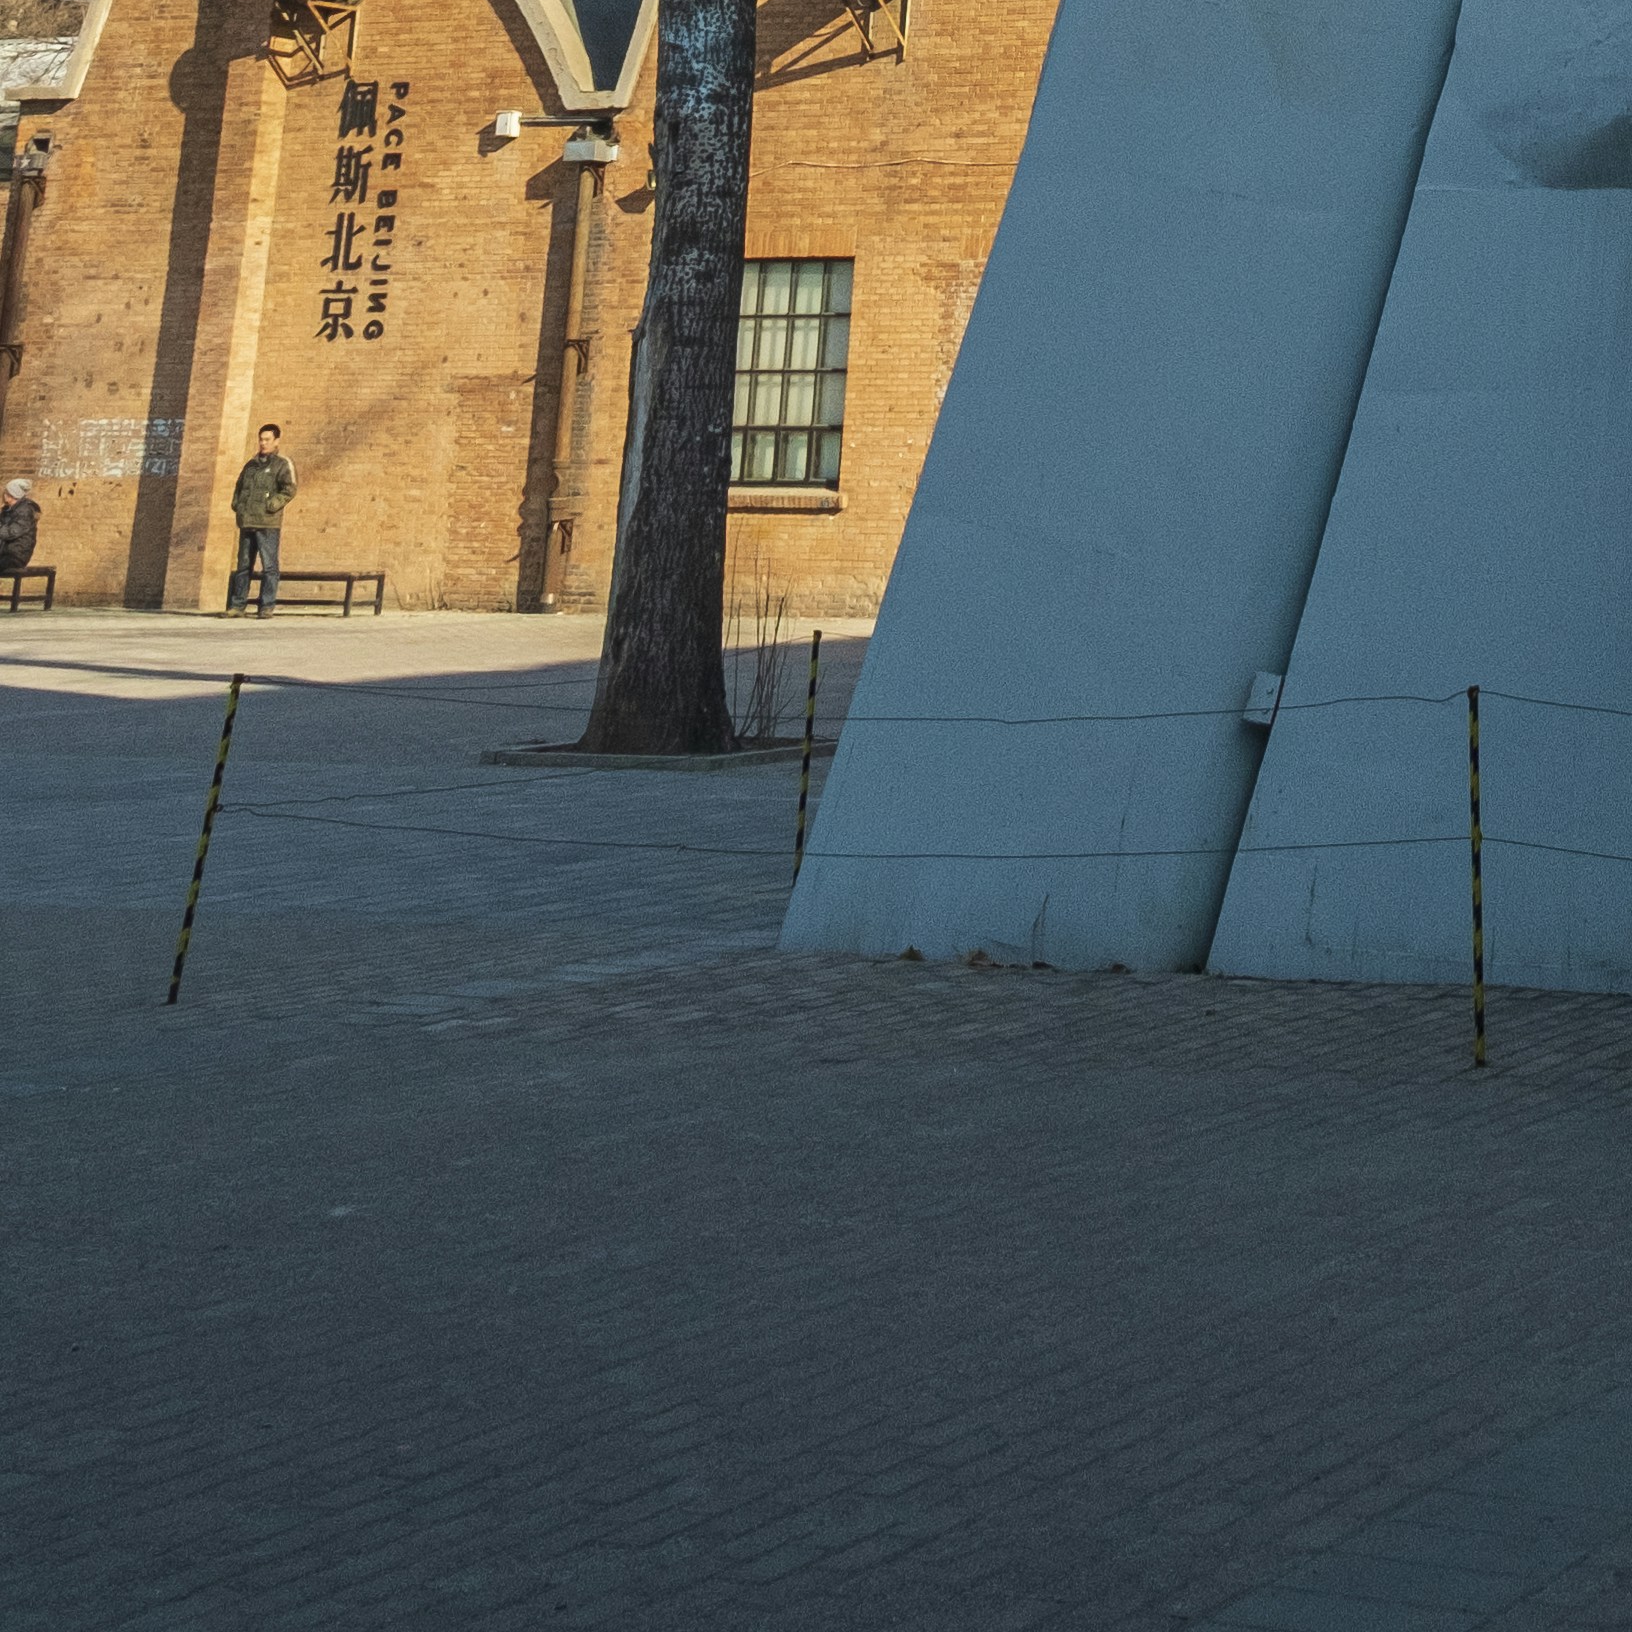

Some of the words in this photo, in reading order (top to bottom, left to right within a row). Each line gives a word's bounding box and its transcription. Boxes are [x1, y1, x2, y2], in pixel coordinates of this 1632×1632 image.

[381, 81, 410, 171] PACE
[313, 79, 379, 342] 佩斯北京
[362, 189, 398, 340] BEIJING
